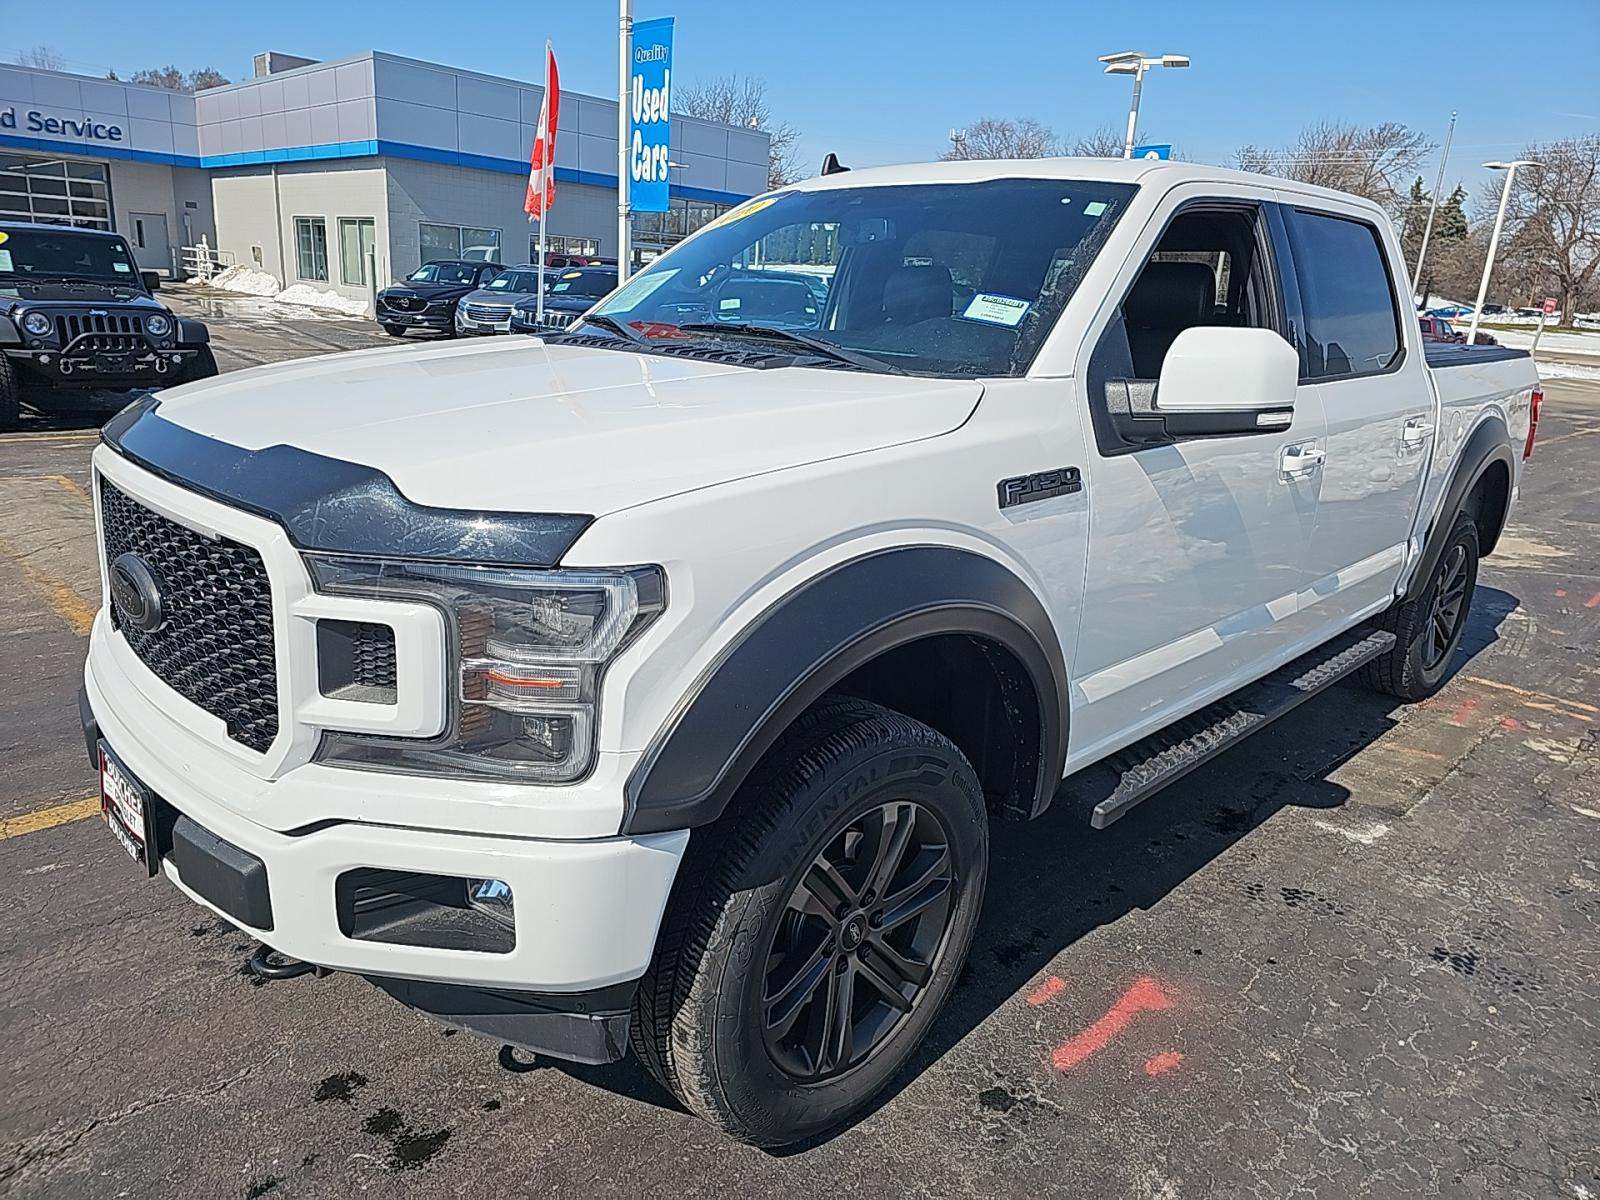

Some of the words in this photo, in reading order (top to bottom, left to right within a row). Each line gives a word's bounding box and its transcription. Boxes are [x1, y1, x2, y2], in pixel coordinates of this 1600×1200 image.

[635, 44, 668, 63] Quality
[632, 68, 670, 125] Used
[26, 110, 123, 142] Service
[631, 129, 668, 183] Cars
